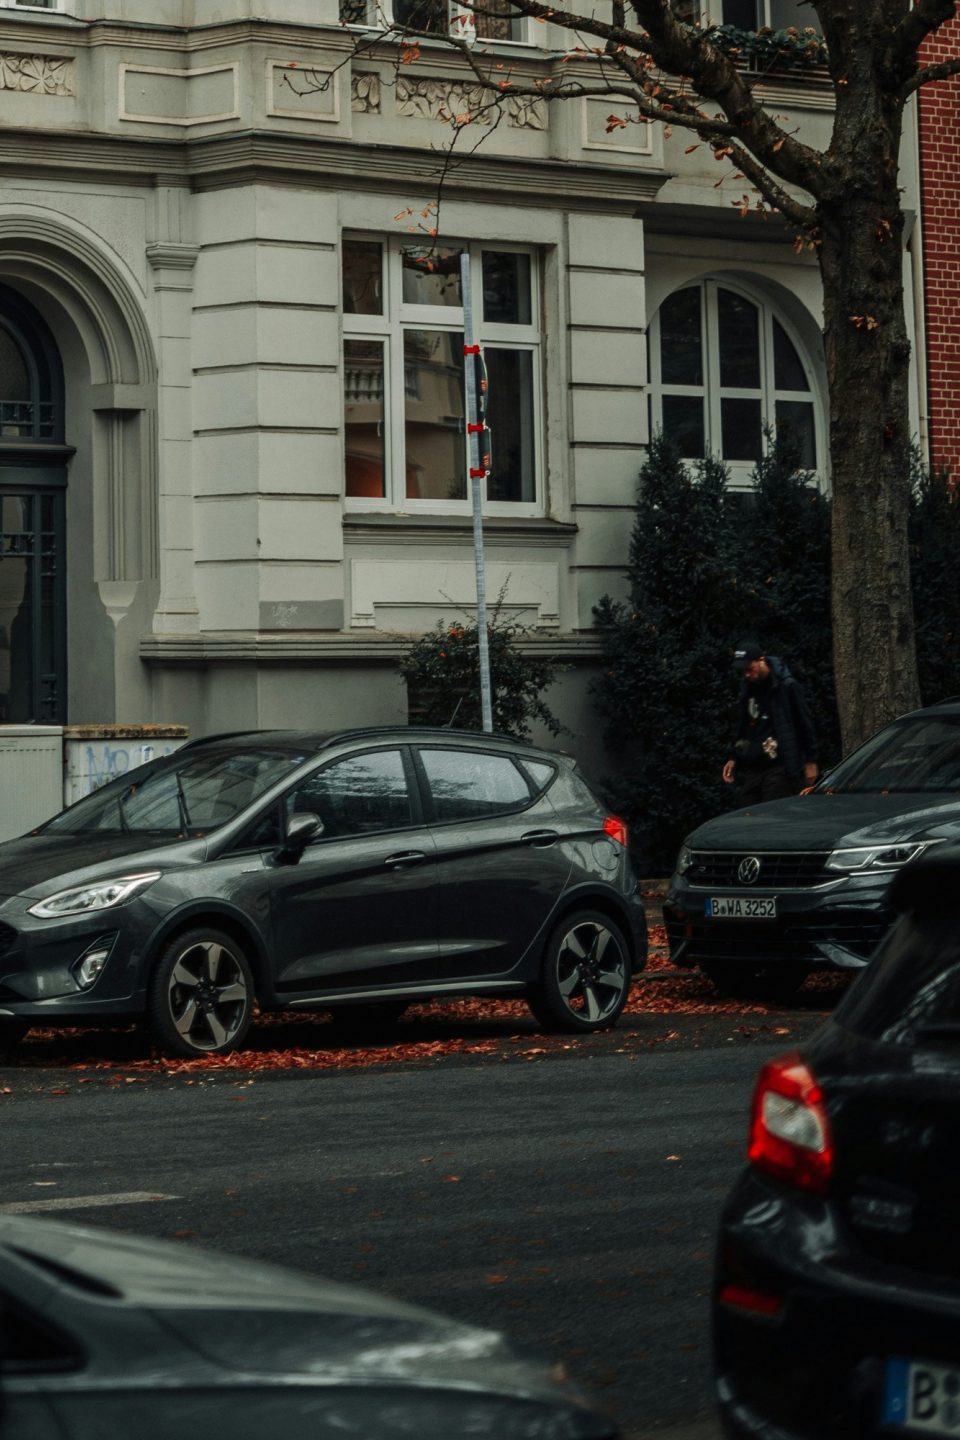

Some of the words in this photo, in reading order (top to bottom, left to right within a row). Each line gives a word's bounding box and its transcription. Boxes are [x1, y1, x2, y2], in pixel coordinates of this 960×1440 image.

[712, 899, 720, 915] B
[727, 899, 742, 916] WA
[744, 900, 775, 917] 3252
[912, 1370, 938, 1421] B
